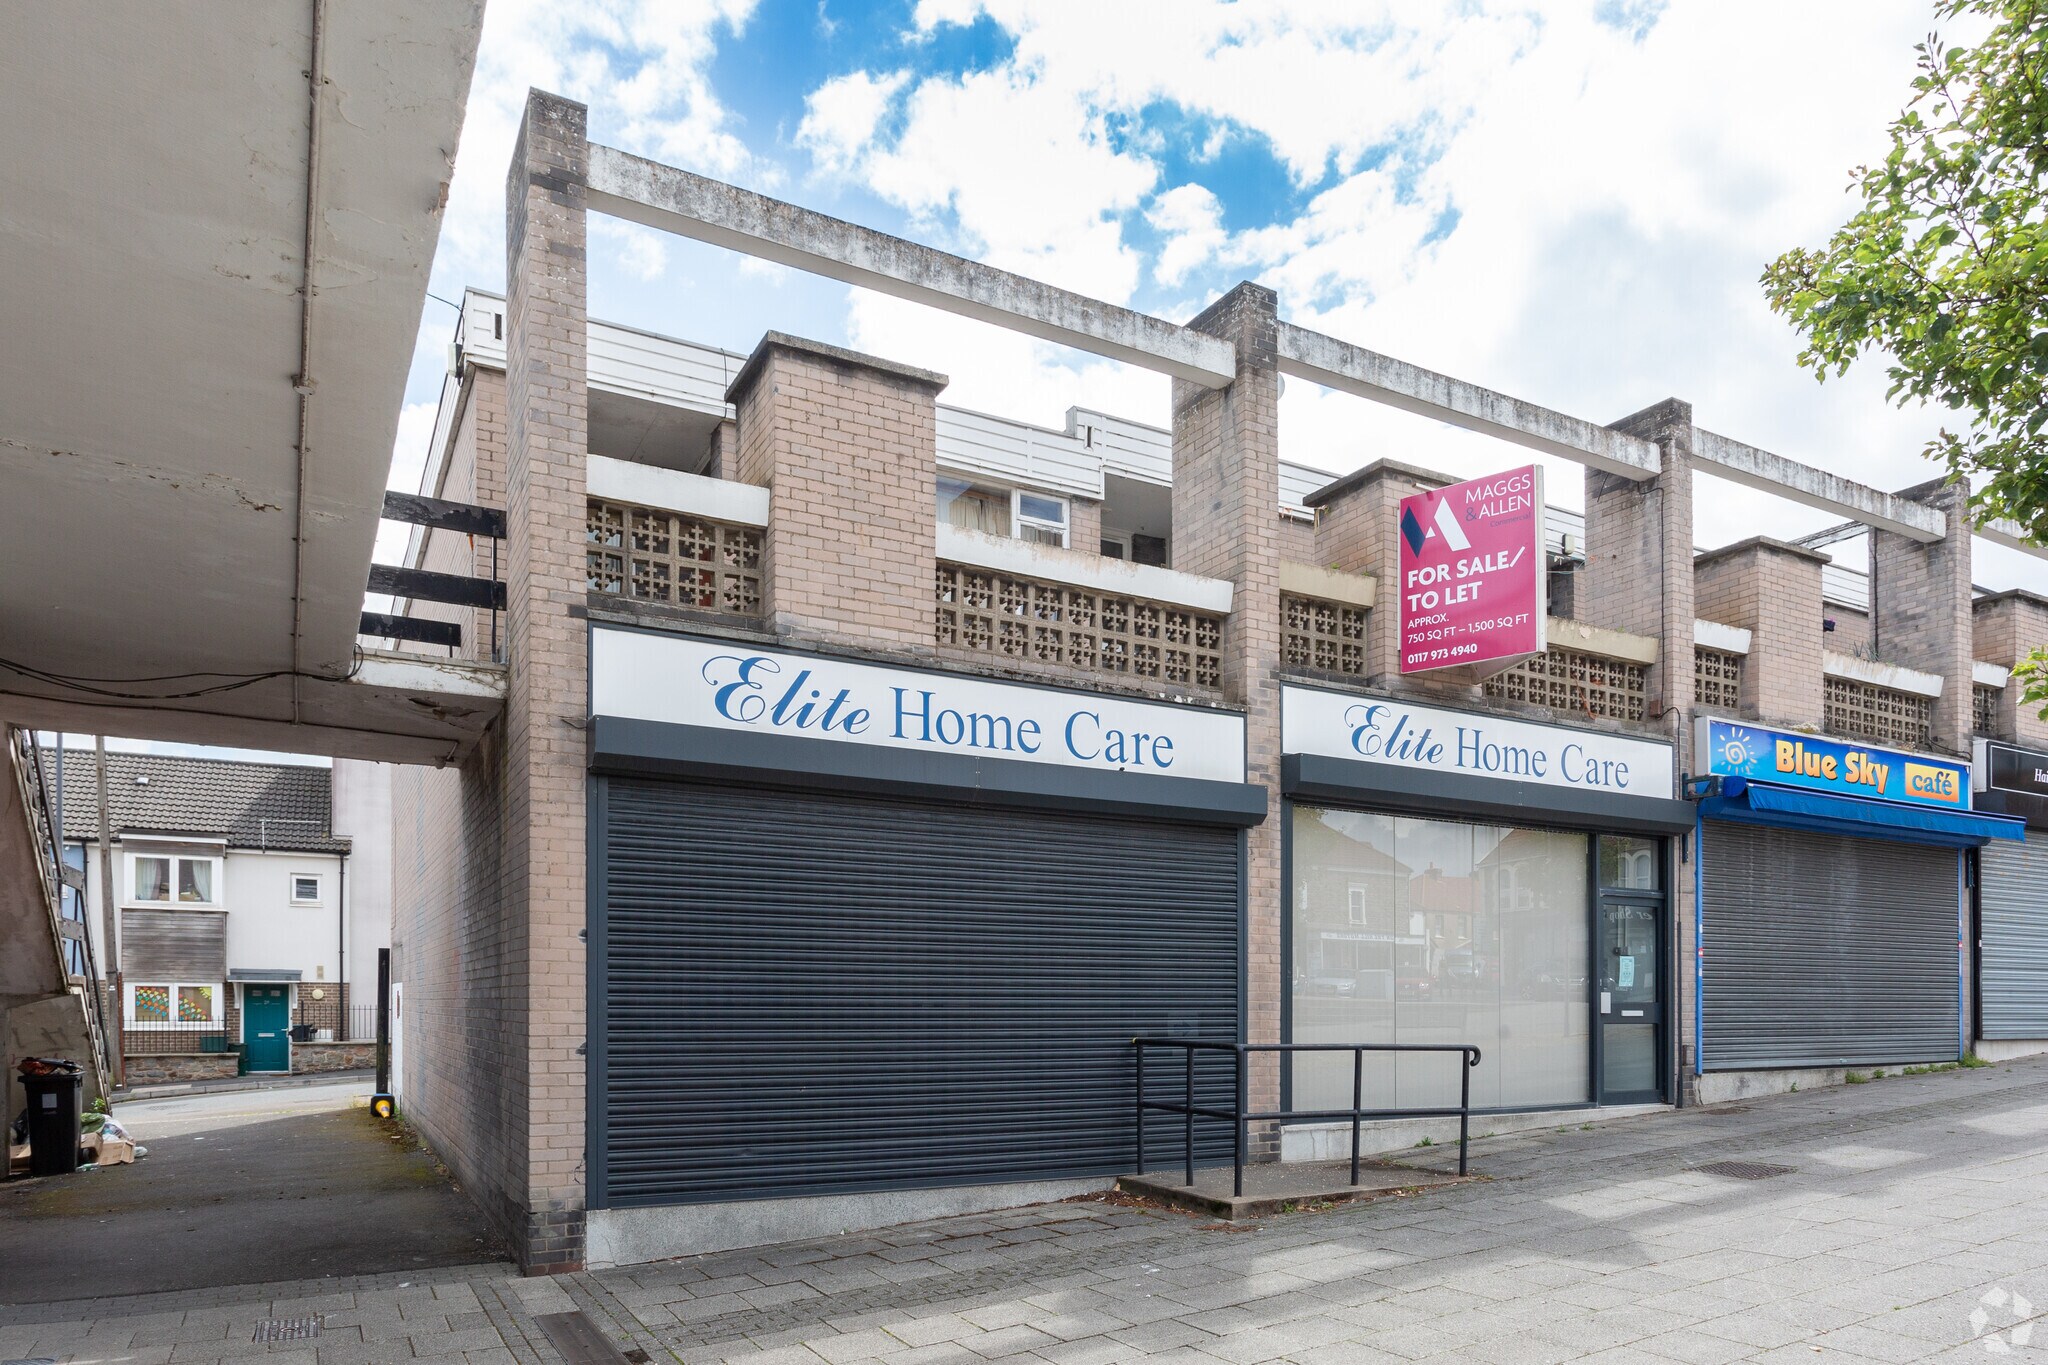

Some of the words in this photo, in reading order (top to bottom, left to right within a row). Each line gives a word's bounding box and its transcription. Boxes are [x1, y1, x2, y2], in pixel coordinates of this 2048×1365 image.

[1465, 474, 1531, 503] MAGGS
[1465, 507, 1477, 522] &
[1478, 492, 1531, 520] ALLEN
[1489, 512, 1531, 527] Commercial
[1407, 563, 1452, 589] FOR
[1456, 545, 1526, 578] SALE/
[1407, 592, 1440, 612] TO
[1445, 581, 1483, 605] LET
[1407, 612, 1450, 629] APPROX.
[1407, 633, 1425, 644] 750
[1427, 628, 1442, 641] SQ
[1444, 626, 1457, 638] FT
[1468, 621, 1495, 634] 1,500
[1497, 616, 1513, 630] SQ
[1515, 613, 1530, 625] FT
[1407, 652, 1428, 665] 0117
[1431, 648, 1449, 660] 973
[1450, 643, 1478, 658] 4940
[702, 656, 871, 735] Elite
[889, 686, 1042, 755] Home
[1064, 711, 1174, 769] Care
[1344, 705, 1444, 764] Elite
[1454, 727, 1547, 778] Home
[1560, 744, 1629, 789] Care
[1775, 739, 1838, 781] Blue
[1844, 752, 1889, 795] Sky
[1912, 770, 1953, 796] café
